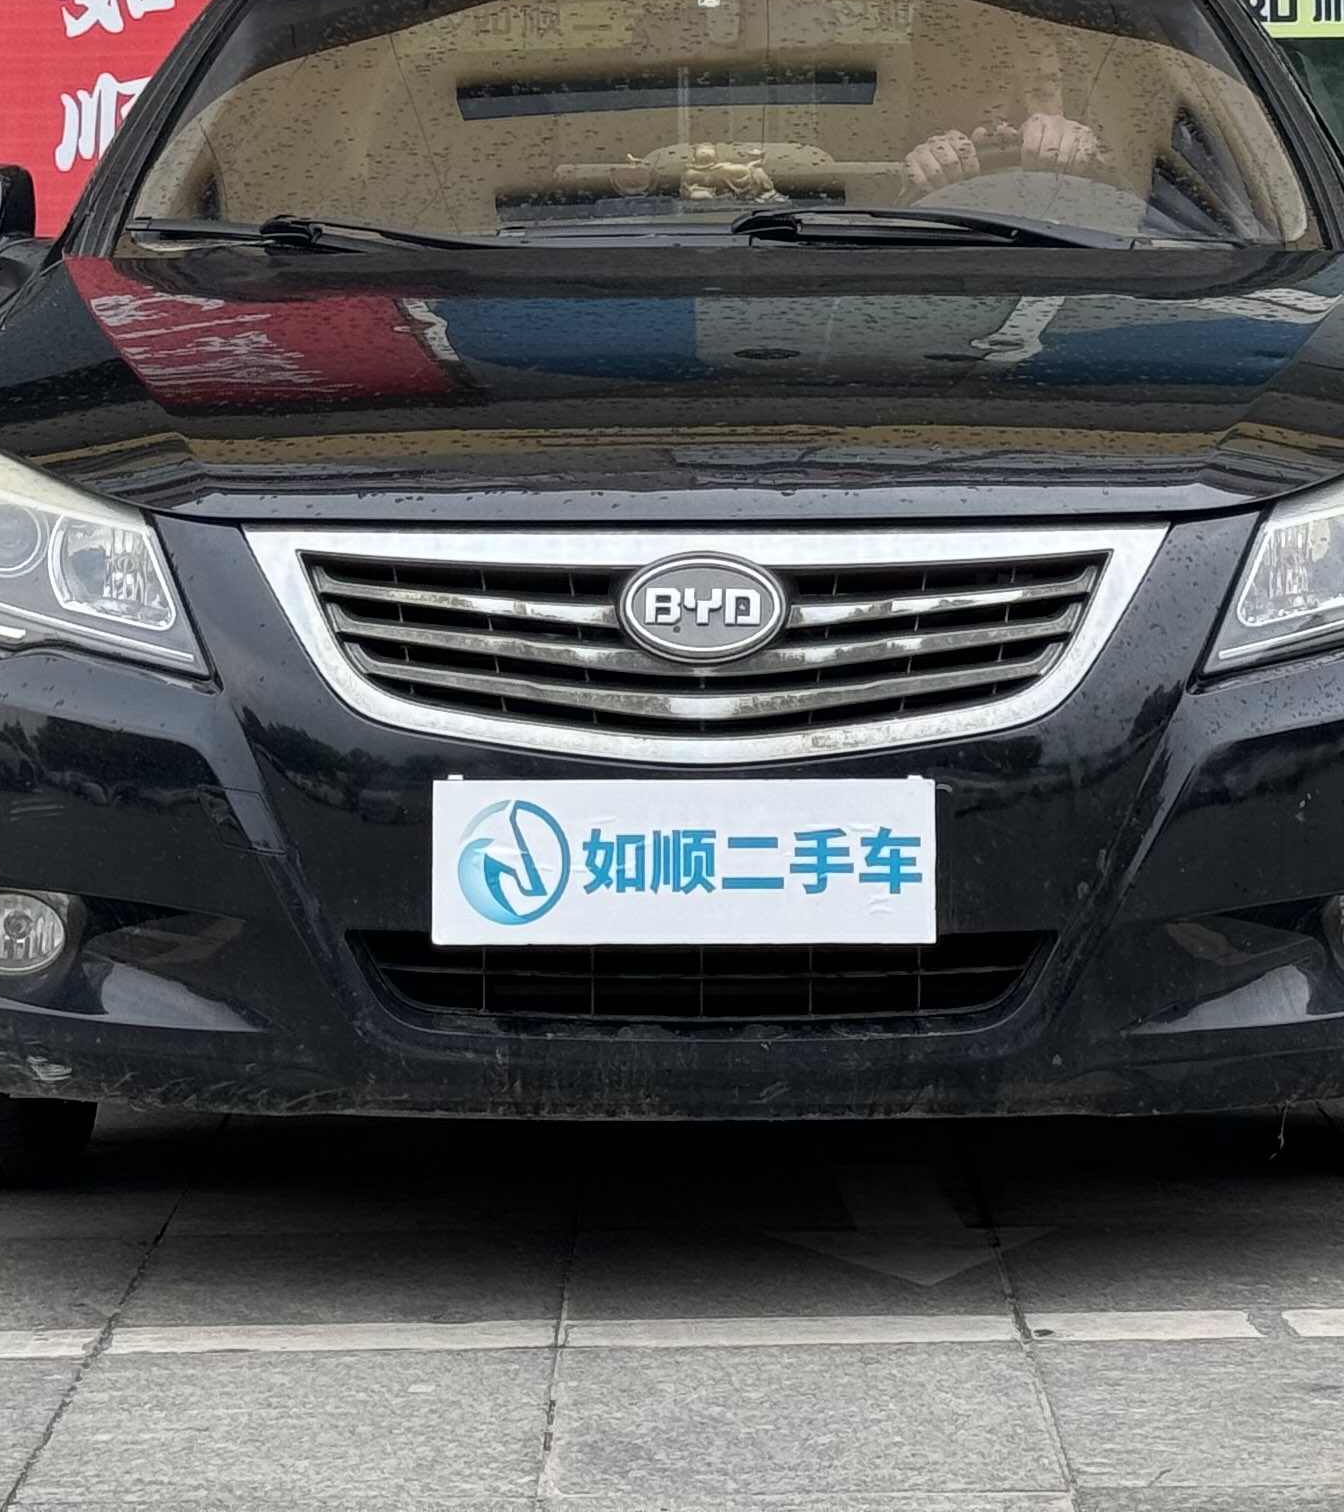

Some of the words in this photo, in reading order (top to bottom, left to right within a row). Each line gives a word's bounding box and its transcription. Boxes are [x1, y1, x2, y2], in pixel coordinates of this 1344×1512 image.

[644, 587, 762, 626] BYD
[582, 827, 923, 895] 如顺二手车
